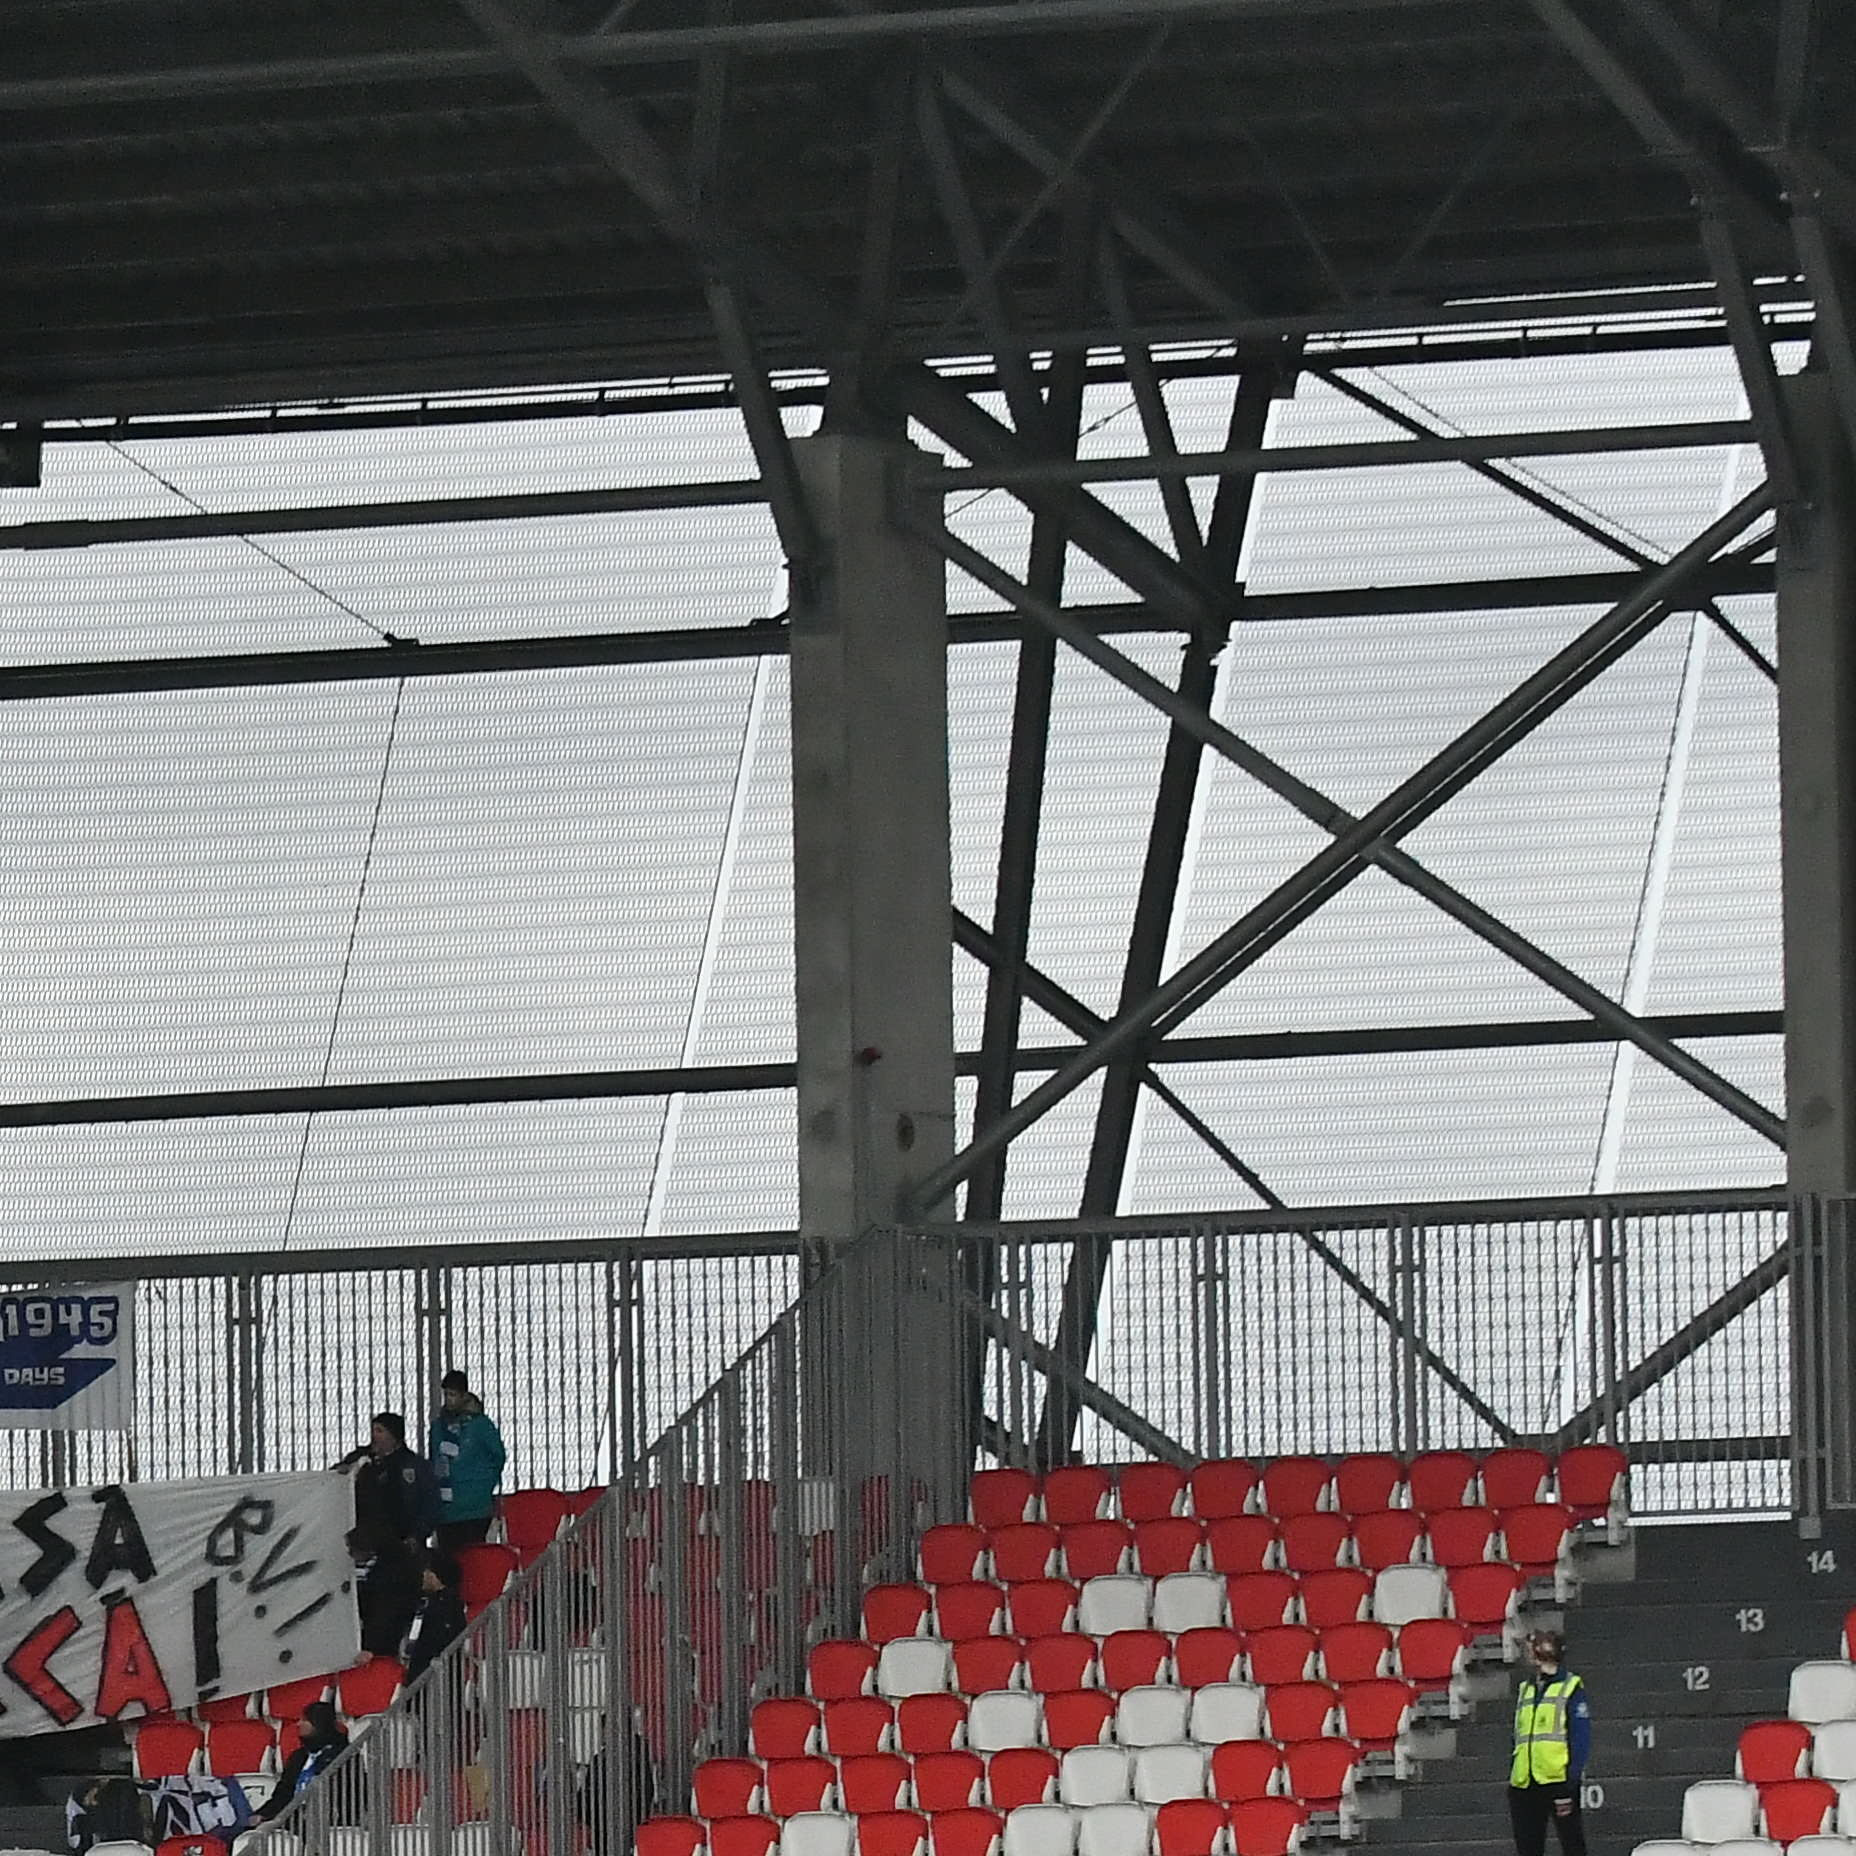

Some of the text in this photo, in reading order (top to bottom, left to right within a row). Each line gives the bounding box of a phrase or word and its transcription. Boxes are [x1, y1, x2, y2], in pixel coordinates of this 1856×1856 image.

[3, 1299, 117, 1339] 1945
[3, 1366, 65, 1387] DAYS
[1807, 1549, 1838, 1574] 14
[1735, 1608, 1765, 1633] 13
[1682, 1666, 1711, 1692] 12
[1632, 1724, 1656, 1750] 11
